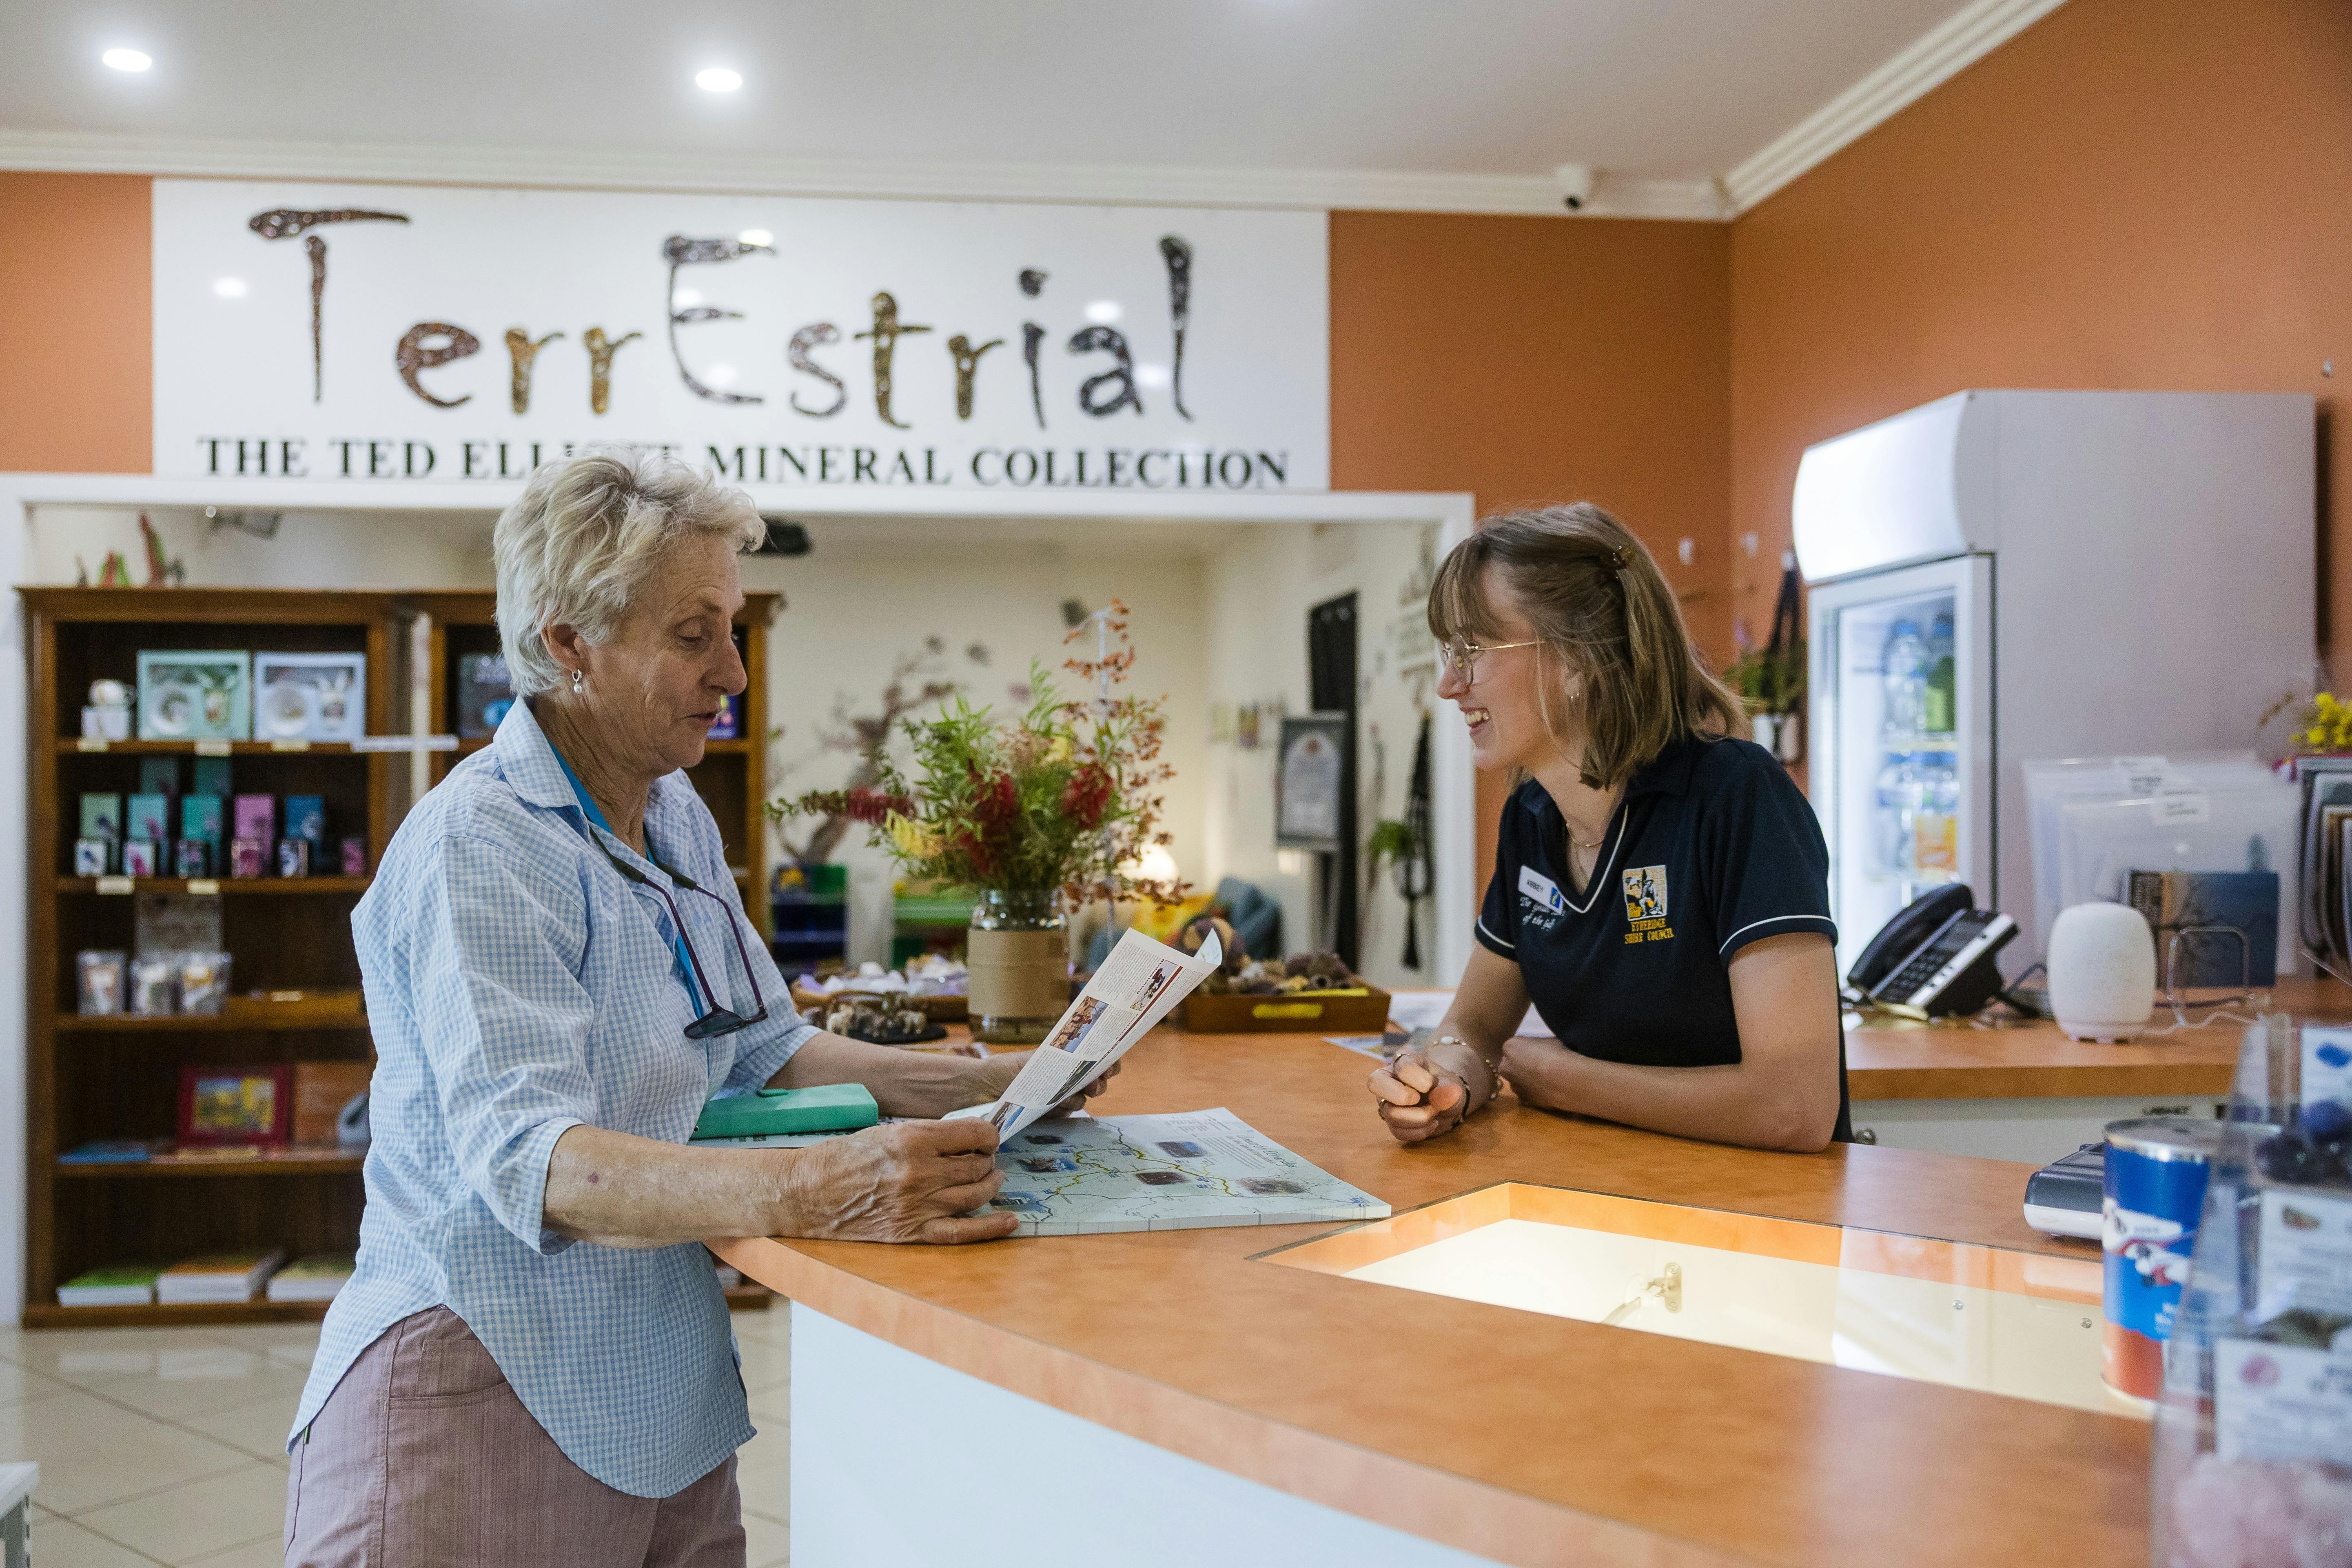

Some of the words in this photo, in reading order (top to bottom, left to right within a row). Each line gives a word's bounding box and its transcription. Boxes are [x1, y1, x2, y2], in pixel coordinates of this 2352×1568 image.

[248, 207, 1195, 429] TerrEstrial
[197, 437, 308, 477] THE
[328, 438, 437, 478] TED
[705, 445, 952, 485] MINERAL
[969, 448, 1288, 488] COLLECTION
[1625, 932, 1643, 944] SHIRE
[1647, 927, 1675, 941] COUNCIL
[1631, 918, 1666, 932] ETHERIDGE
[1137, 959, 1164, 994] Birdwatching
